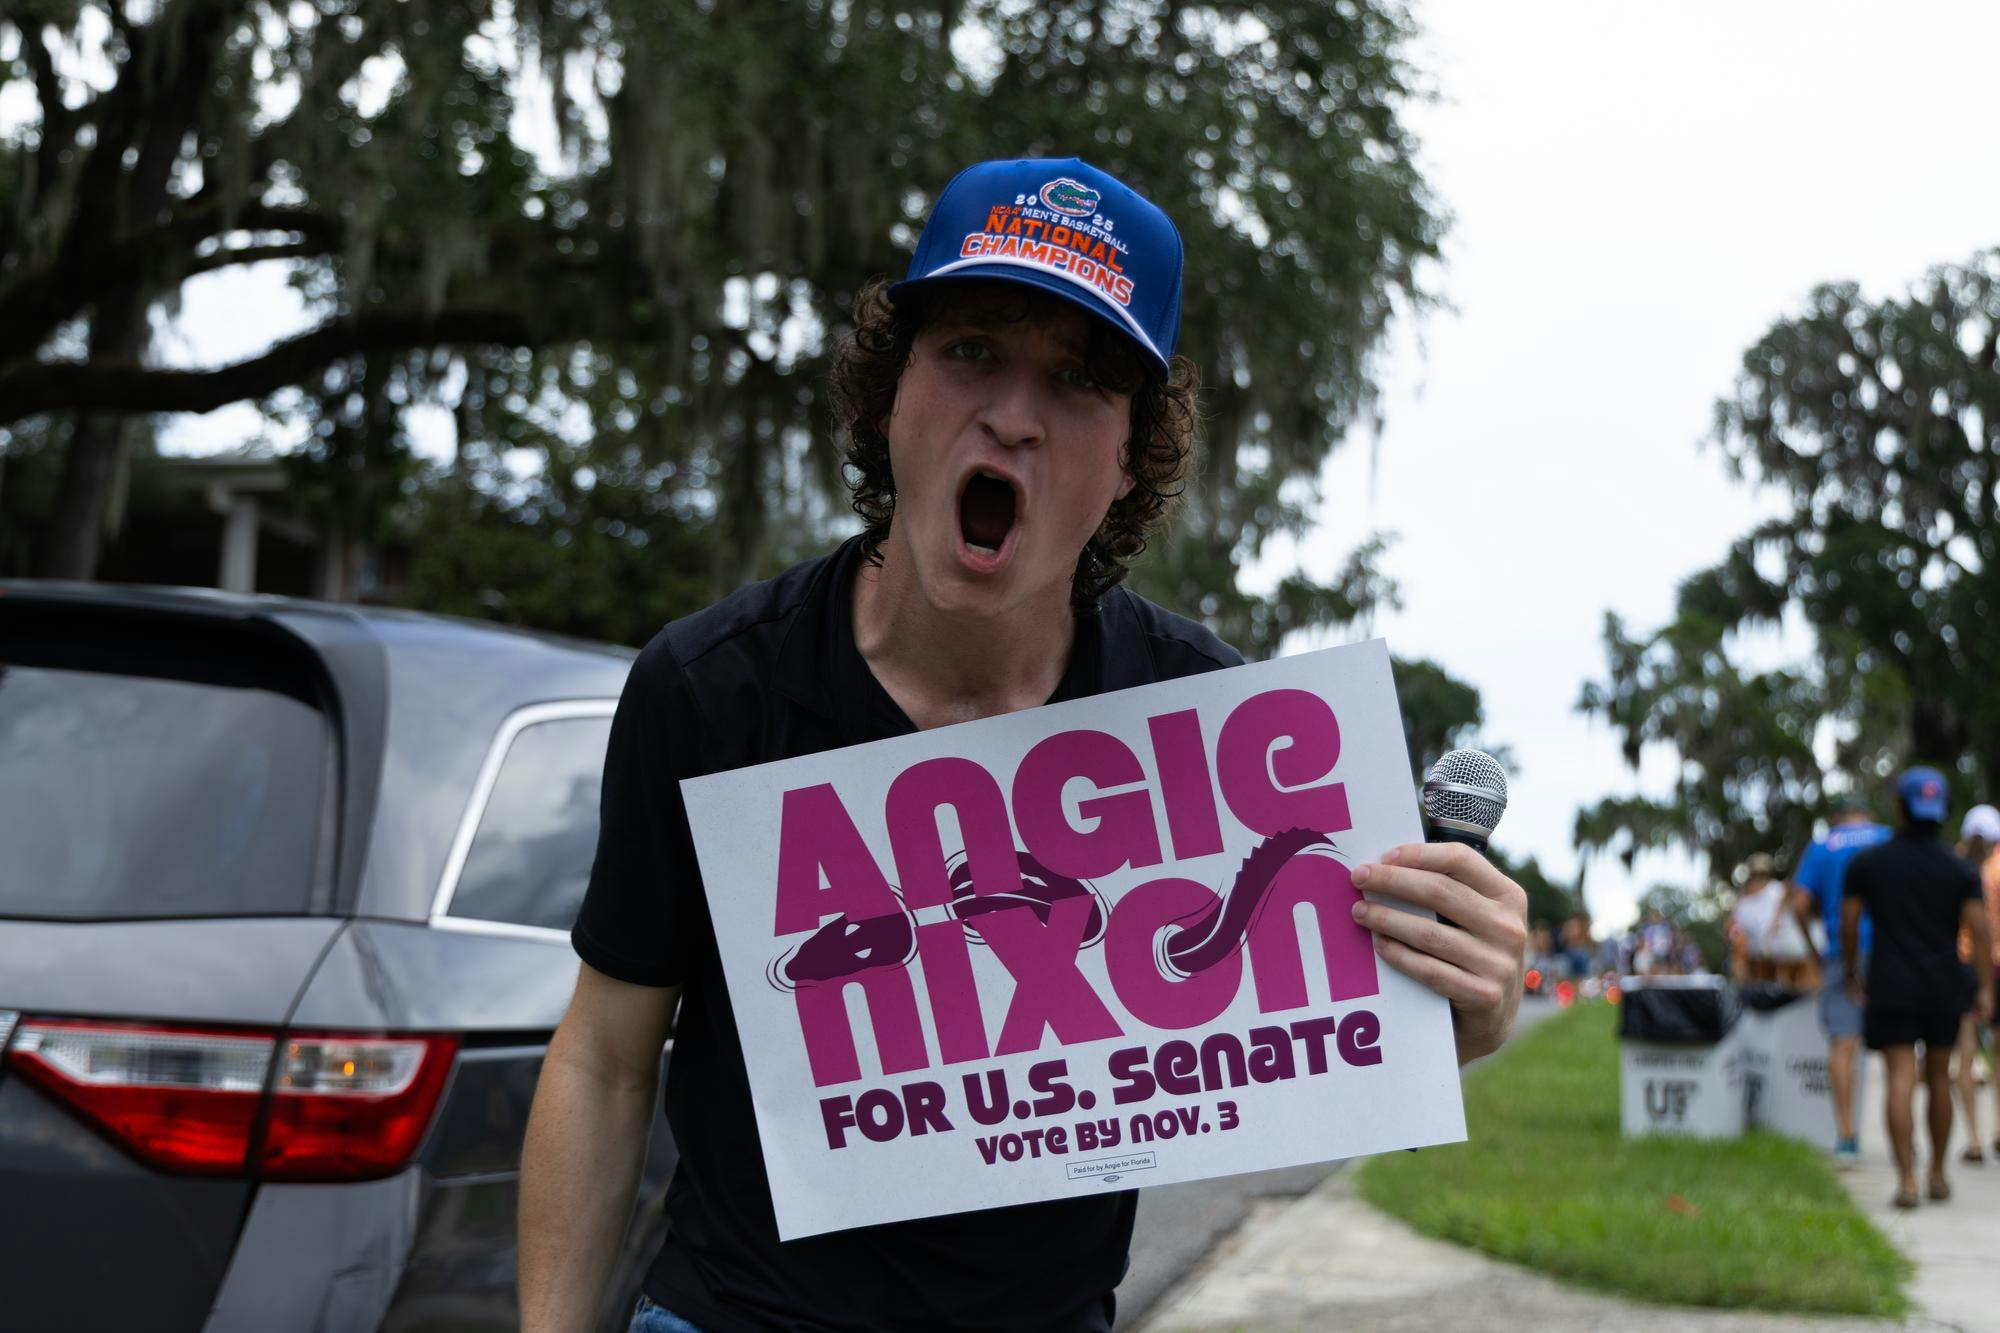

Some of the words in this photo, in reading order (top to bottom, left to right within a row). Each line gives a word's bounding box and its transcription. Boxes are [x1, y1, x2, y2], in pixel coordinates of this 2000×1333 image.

[1014, 193, 1037, 206] 20
[1092, 213, 1114, 231] 25
[1021, 207, 1060, 223] MEN'S
[983, 214, 1123, 273] NATIONAL
[960, 233, 1134, 306] CHAMPIONS
[820, 1082, 954, 1150] FOR
[962, 1059, 1096, 1125] U.S.
[1217, 1101, 1240, 1131] 3
[1073, 1166, 1086, 1174] Paid
[1096, 1164, 1103, 1172] by
[1104, 1162, 1121, 1170] Angie
[1131, 1157, 1150, 1166] Florida
